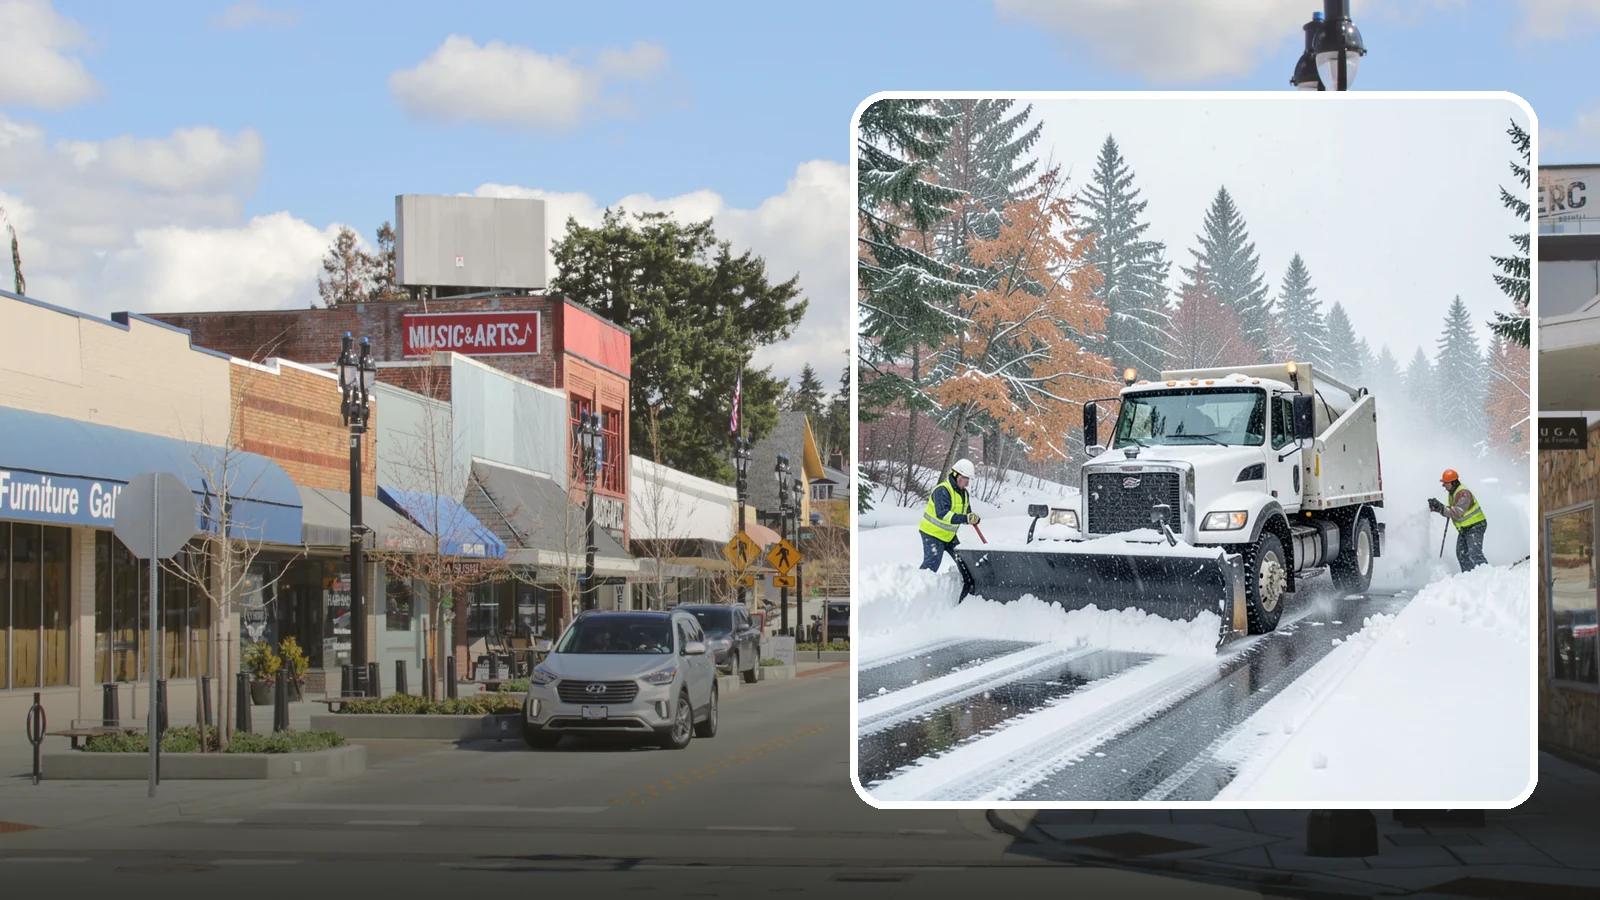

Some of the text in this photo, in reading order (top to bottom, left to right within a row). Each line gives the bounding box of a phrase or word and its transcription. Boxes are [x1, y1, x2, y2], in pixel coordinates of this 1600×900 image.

[408, 322, 520, 348] MUSIC&ARTS
[1540, 427, 1577, 437] UGA
[1551, 436, 1579, 445] Framing
[0, 471, 121, 519] Furniture Gal
[453, 563, 479, 574] SUSHI
